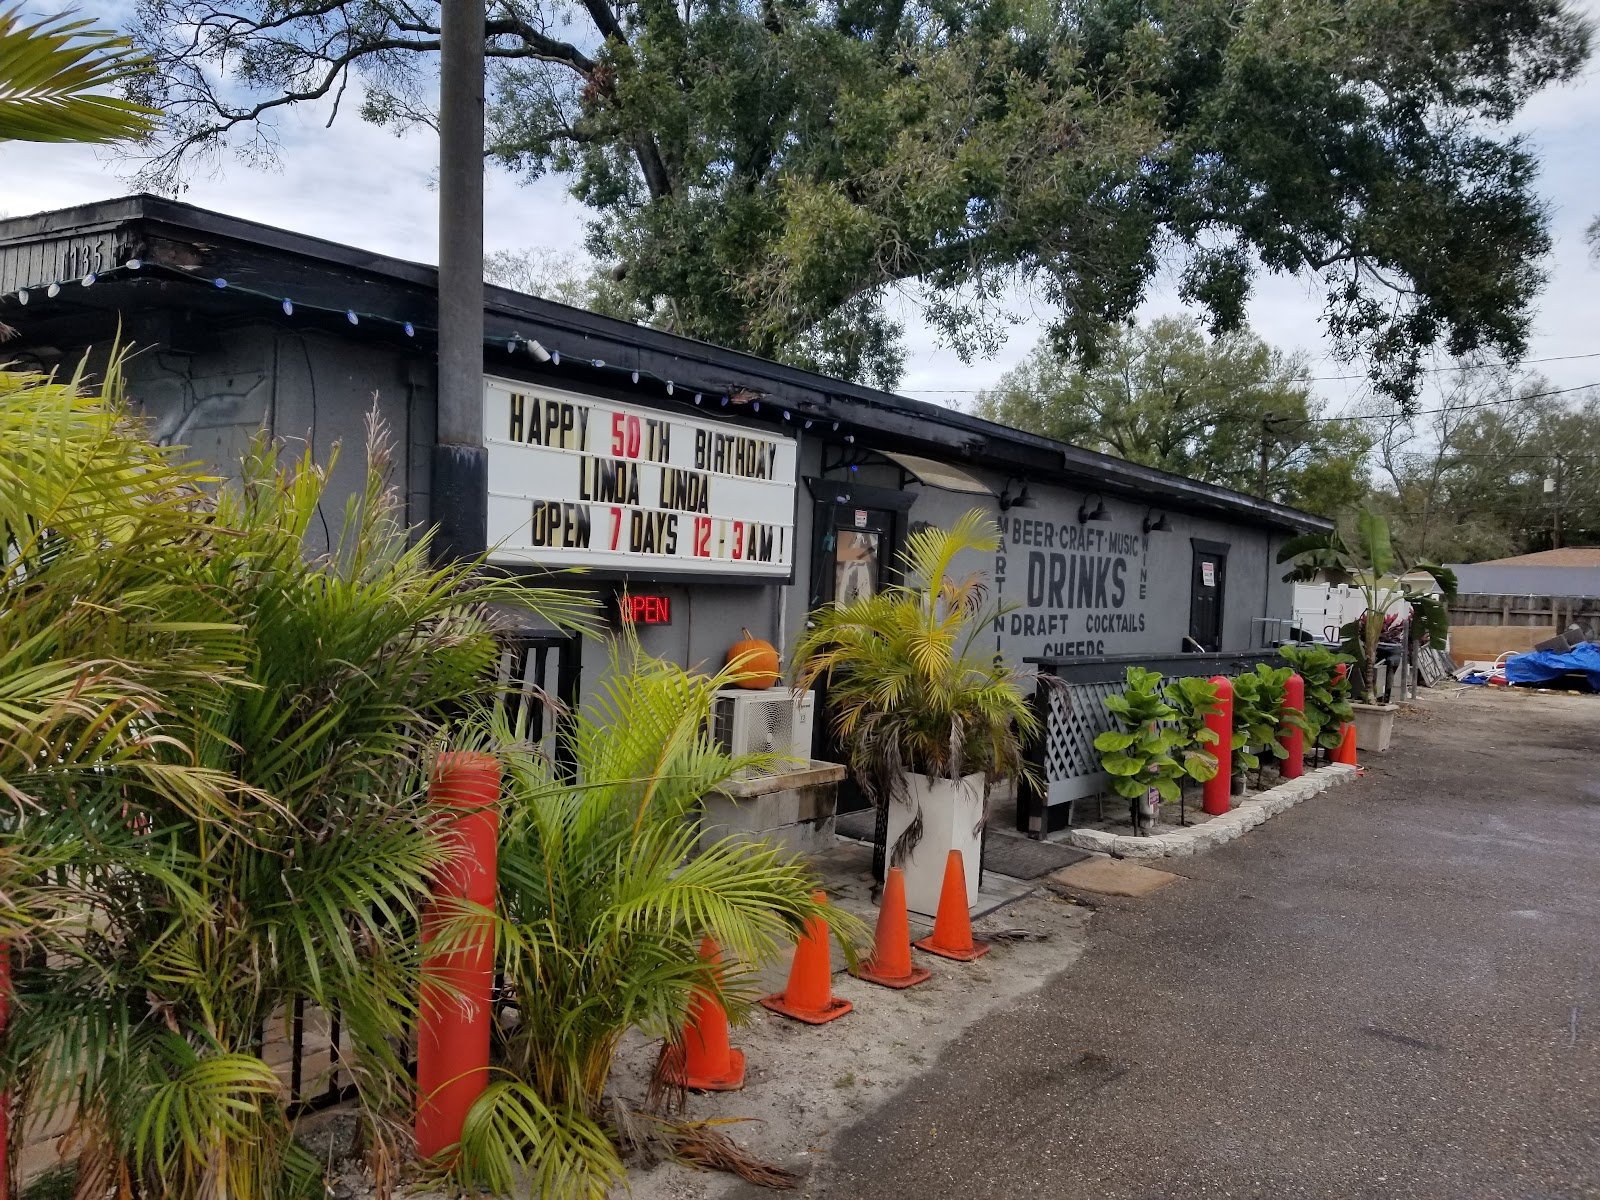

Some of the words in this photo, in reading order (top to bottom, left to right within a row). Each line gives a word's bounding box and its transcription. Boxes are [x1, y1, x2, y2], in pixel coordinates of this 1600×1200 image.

[509, 393, 589, 451] HAPPY
[695, 428, 777, 480] BIRTHDAY
[580, 456, 640, 506] LINDA
[660, 467, 708, 514] LINDA
[532, 500, 591, 548] OPEN
[610, 507, 622, 550] 7
[630, 510, 678, 554] DAYS
[993, 516, 1009, 677] MARTINIS
[1027, 551, 1127, 609] DRINKS
[1139, 536, 1149, 599] WINE
[620, 595, 669, 623] OPEN
[1010, 613, 1069, 636] DRAFT
[1086, 613, 1145, 633] COCKTAILS
